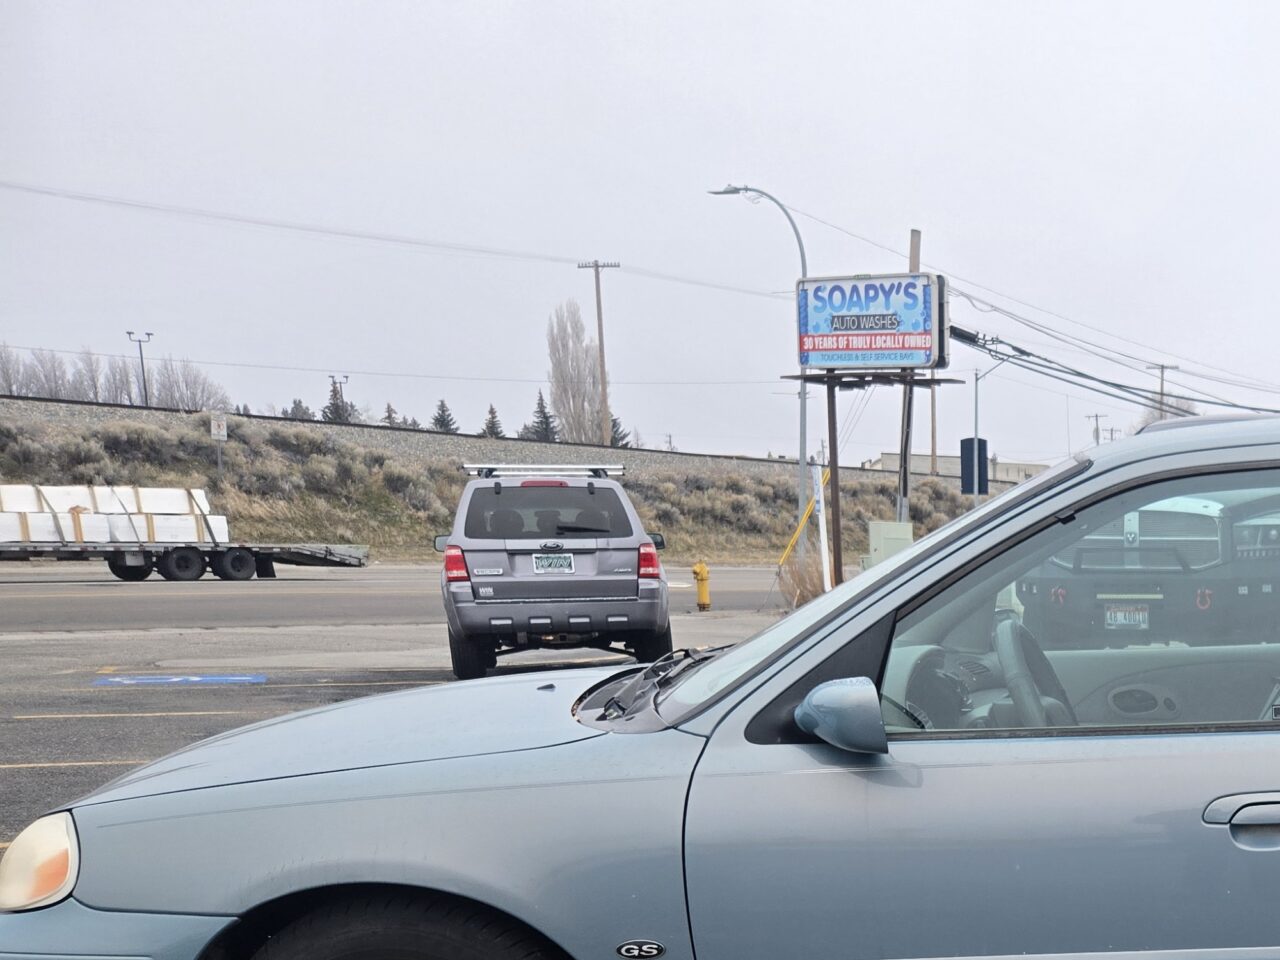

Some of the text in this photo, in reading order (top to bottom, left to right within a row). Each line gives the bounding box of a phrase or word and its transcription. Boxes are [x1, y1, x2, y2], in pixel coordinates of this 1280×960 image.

[812, 282, 919, 313] SOAPY'S
[832, 315, 898, 330] AUTO WASHES
[803, 335, 931, 350] 30 YEARS OF TRULY LOCALLY OWNED
[620, 944, 660, 956] GS
